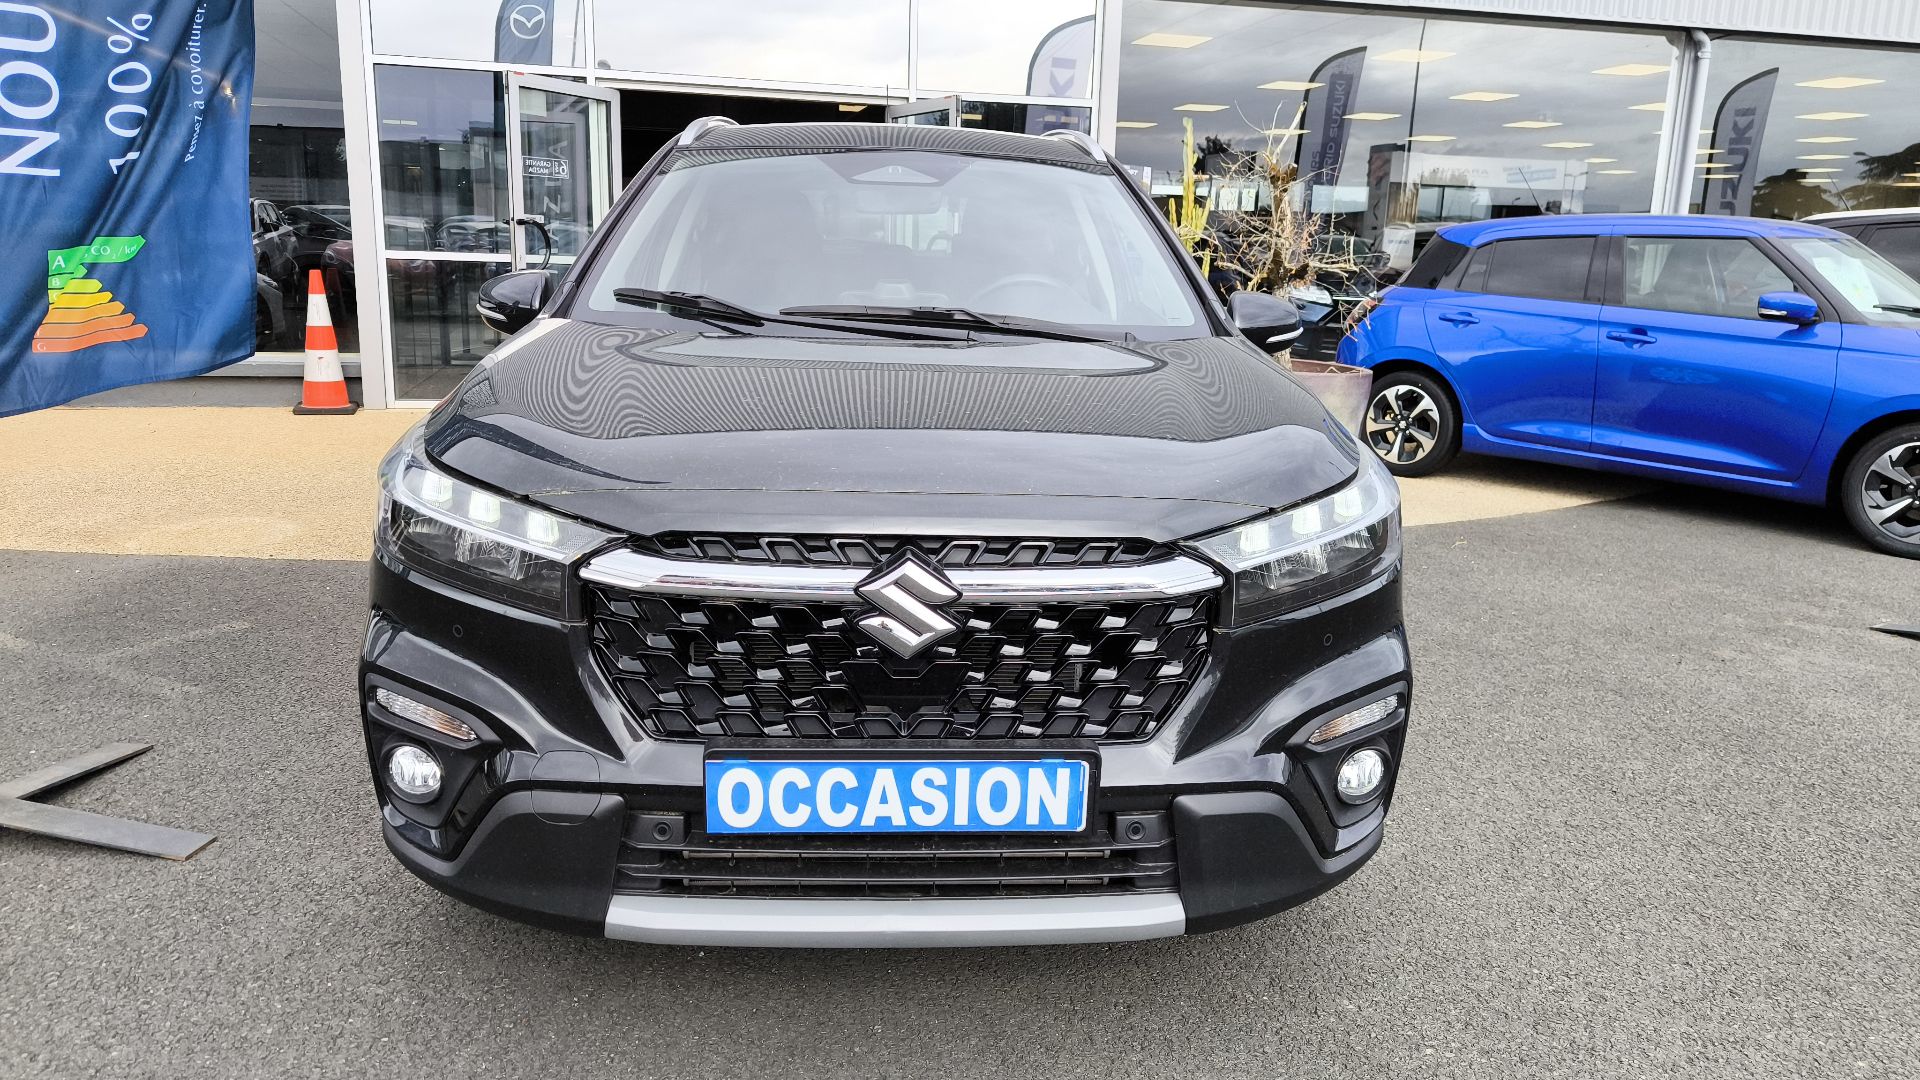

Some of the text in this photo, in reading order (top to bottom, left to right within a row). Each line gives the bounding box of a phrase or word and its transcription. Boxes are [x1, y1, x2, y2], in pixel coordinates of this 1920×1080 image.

[105, 14, 153, 175] 100%
[184, 3, 207, 162] Pensez à covoiturer.
[1329, 80, 1346, 137] SUZUKI
[1719, 106, 1757, 216] UZUKI
[51, 278, 60, 286] B
[52, 256, 65, 270] A
[717, 767, 1071, 829] OCCASION
